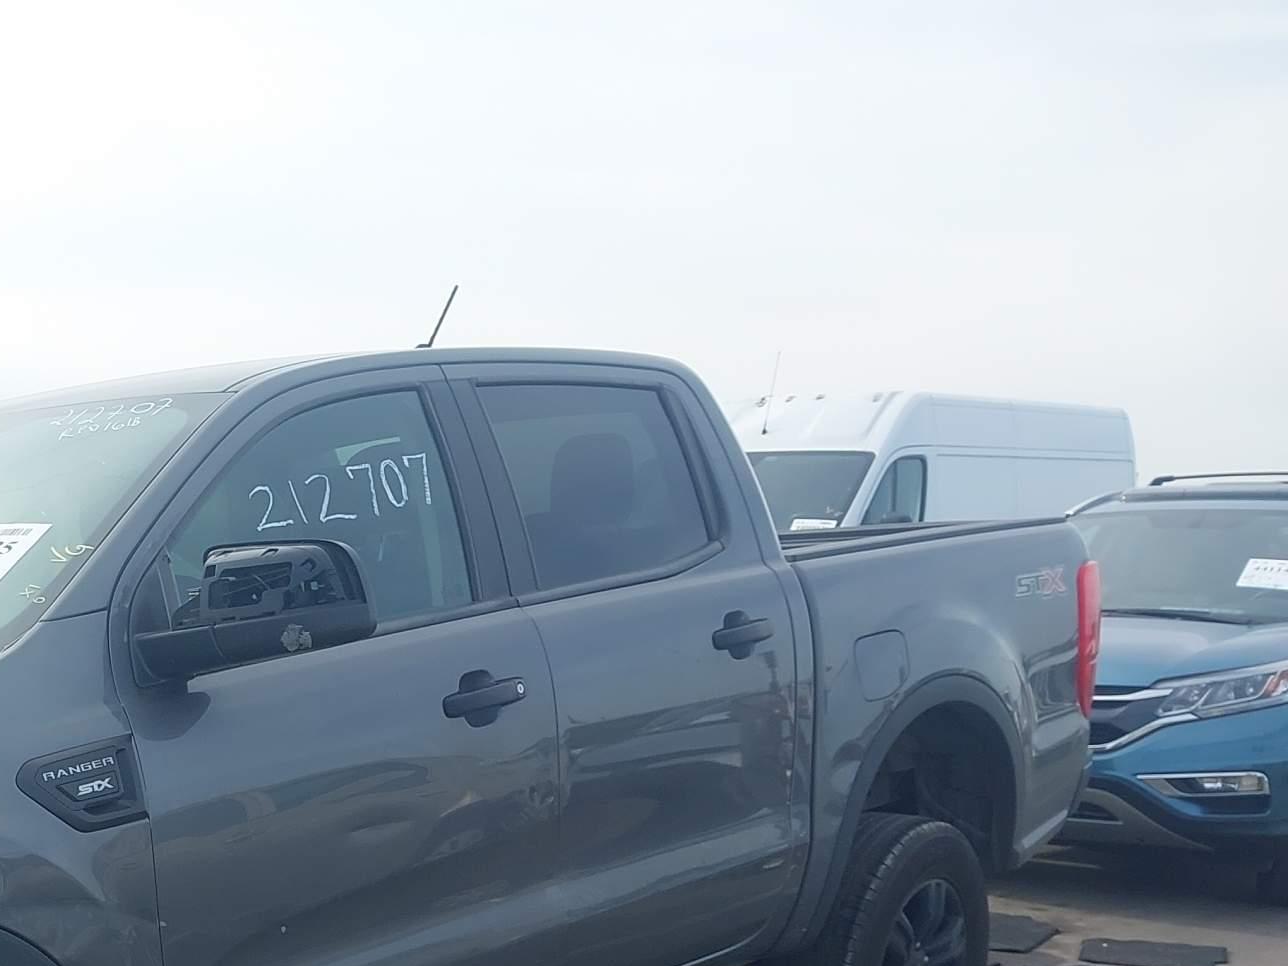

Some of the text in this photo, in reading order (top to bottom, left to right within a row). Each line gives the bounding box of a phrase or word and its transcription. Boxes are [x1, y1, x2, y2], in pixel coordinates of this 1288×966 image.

[49, 397, 174, 426] 212707
[248, 452, 432, 532] 212707
[1015, 568, 1066, 598] STX
[42, 756, 115, 782] RANGER
[77, 776, 114, 796] STX
